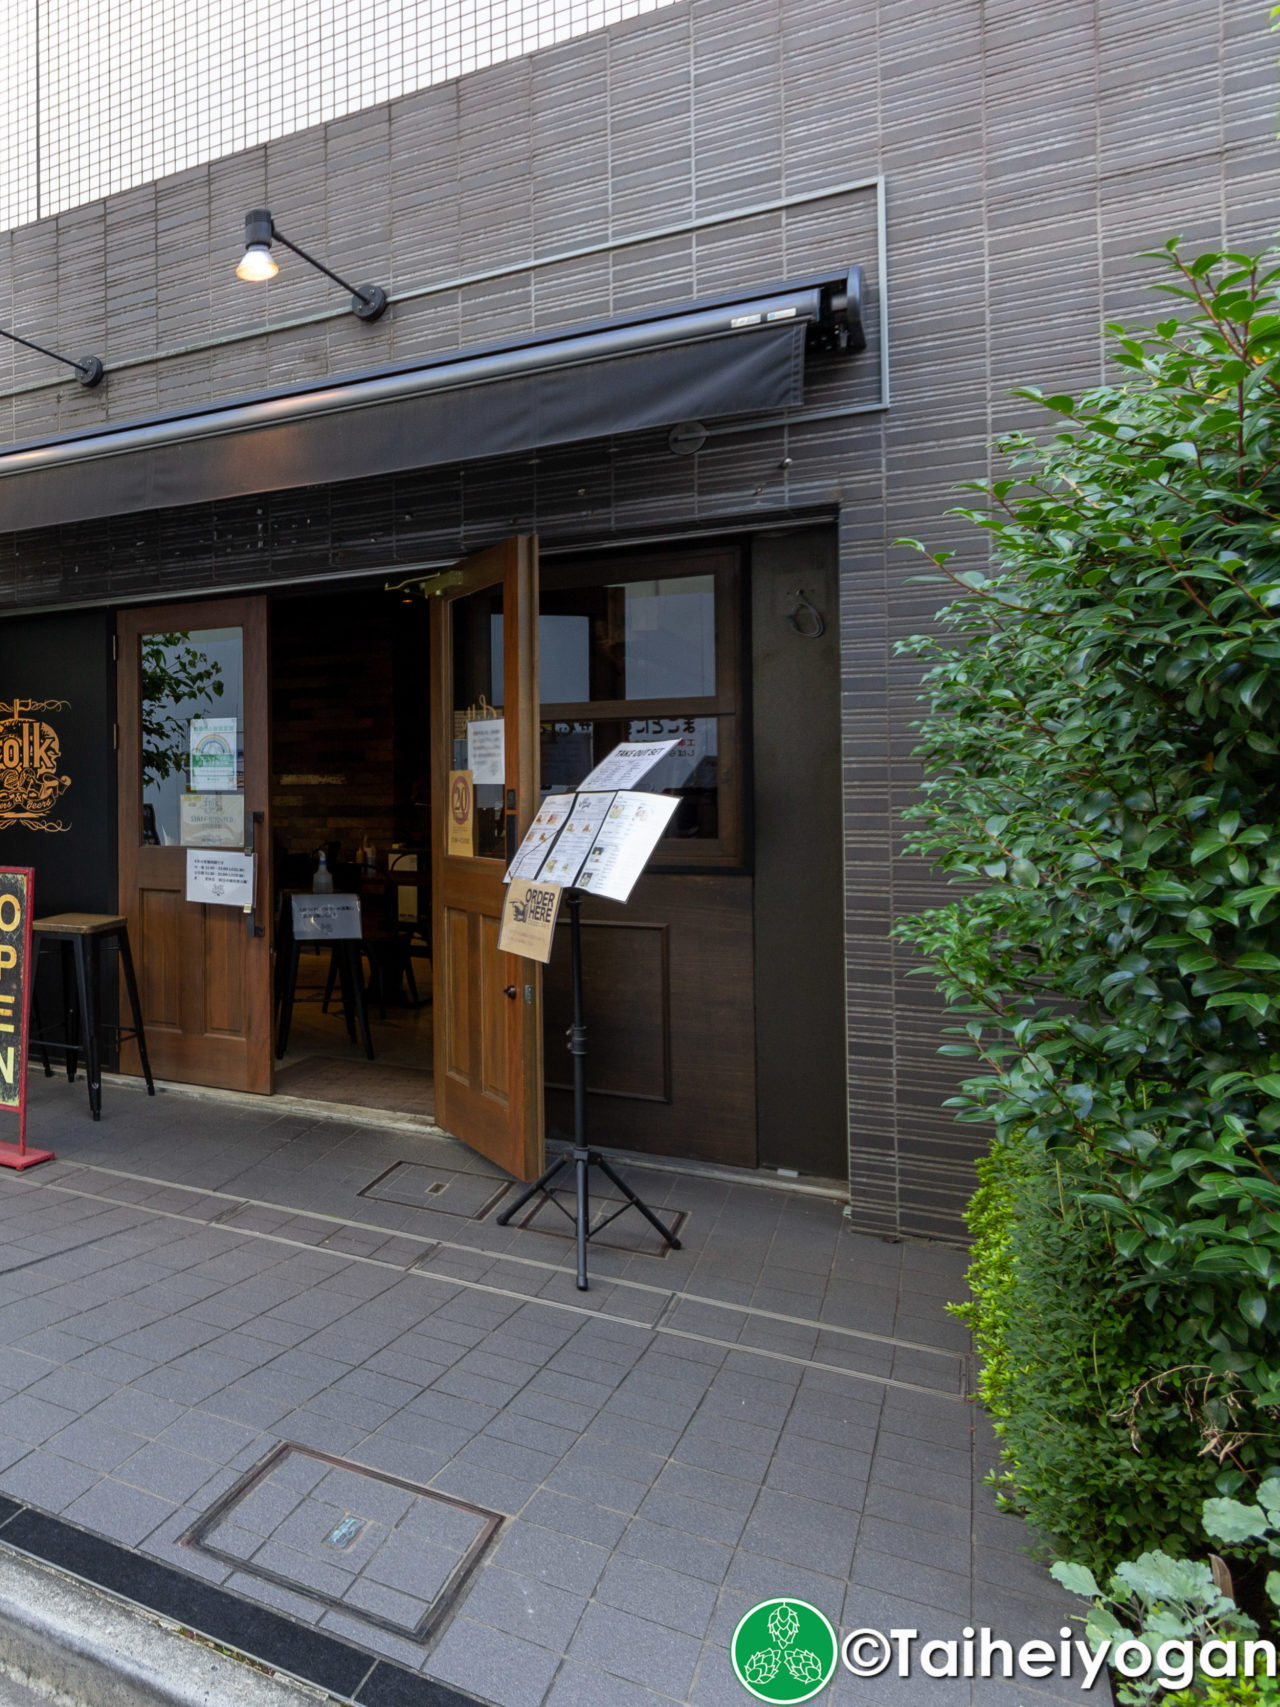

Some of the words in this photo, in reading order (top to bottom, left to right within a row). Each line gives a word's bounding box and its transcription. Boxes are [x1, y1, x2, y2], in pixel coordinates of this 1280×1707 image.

[615, 749, 635, 757] TAKE
[633, 748, 651, 757] OUT
[648, 747, 665, 756] SET
[15, 793, 23, 803] &
[26, 798, 51, 810] Beers
[525, 888, 556, 908] ORDER
[528, 905, 553, 923] HERE
